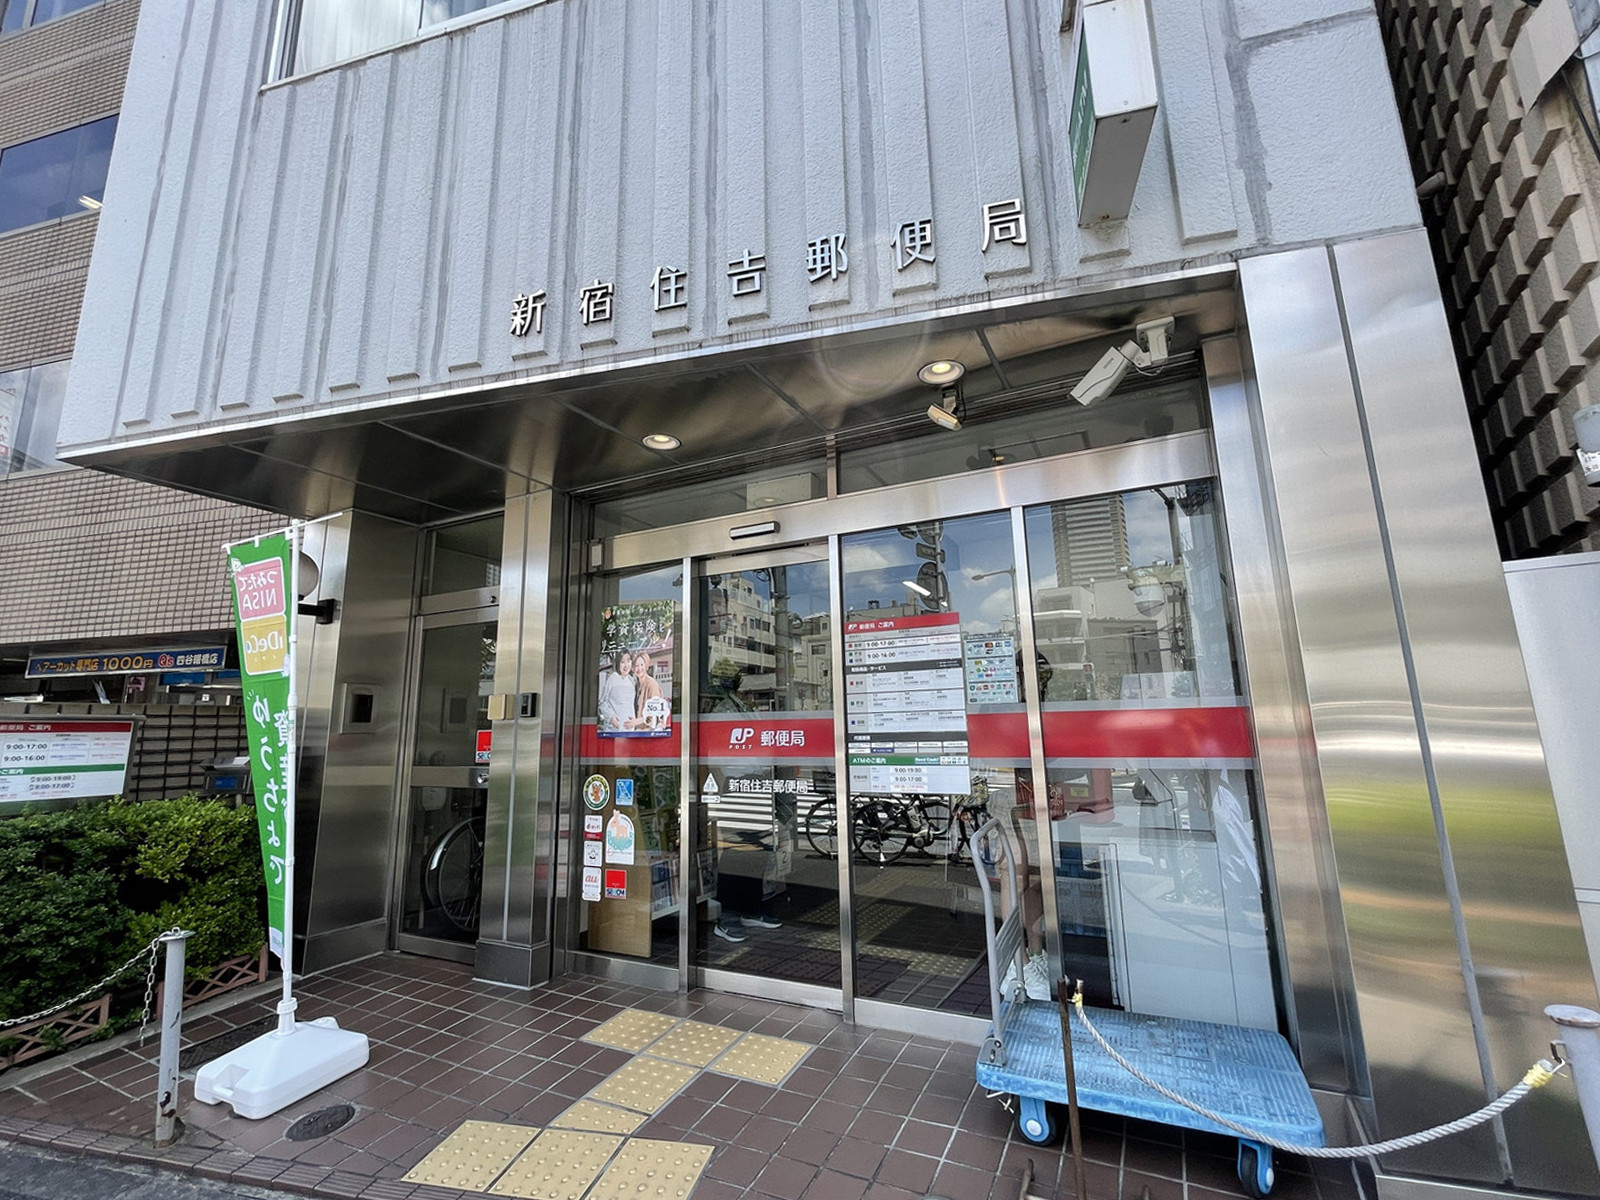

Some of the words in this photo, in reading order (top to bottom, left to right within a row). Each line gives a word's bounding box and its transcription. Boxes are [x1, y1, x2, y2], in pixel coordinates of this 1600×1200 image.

[509, 197, 1028, 337] 新宿住吉郵便局
[102, 655, 154, 671] 1000円
[760, 730, 805, 747] 郵便局
[728, 778, 809, 794] 新宿住吉郵便局
[584, 875, 599, 884] au
